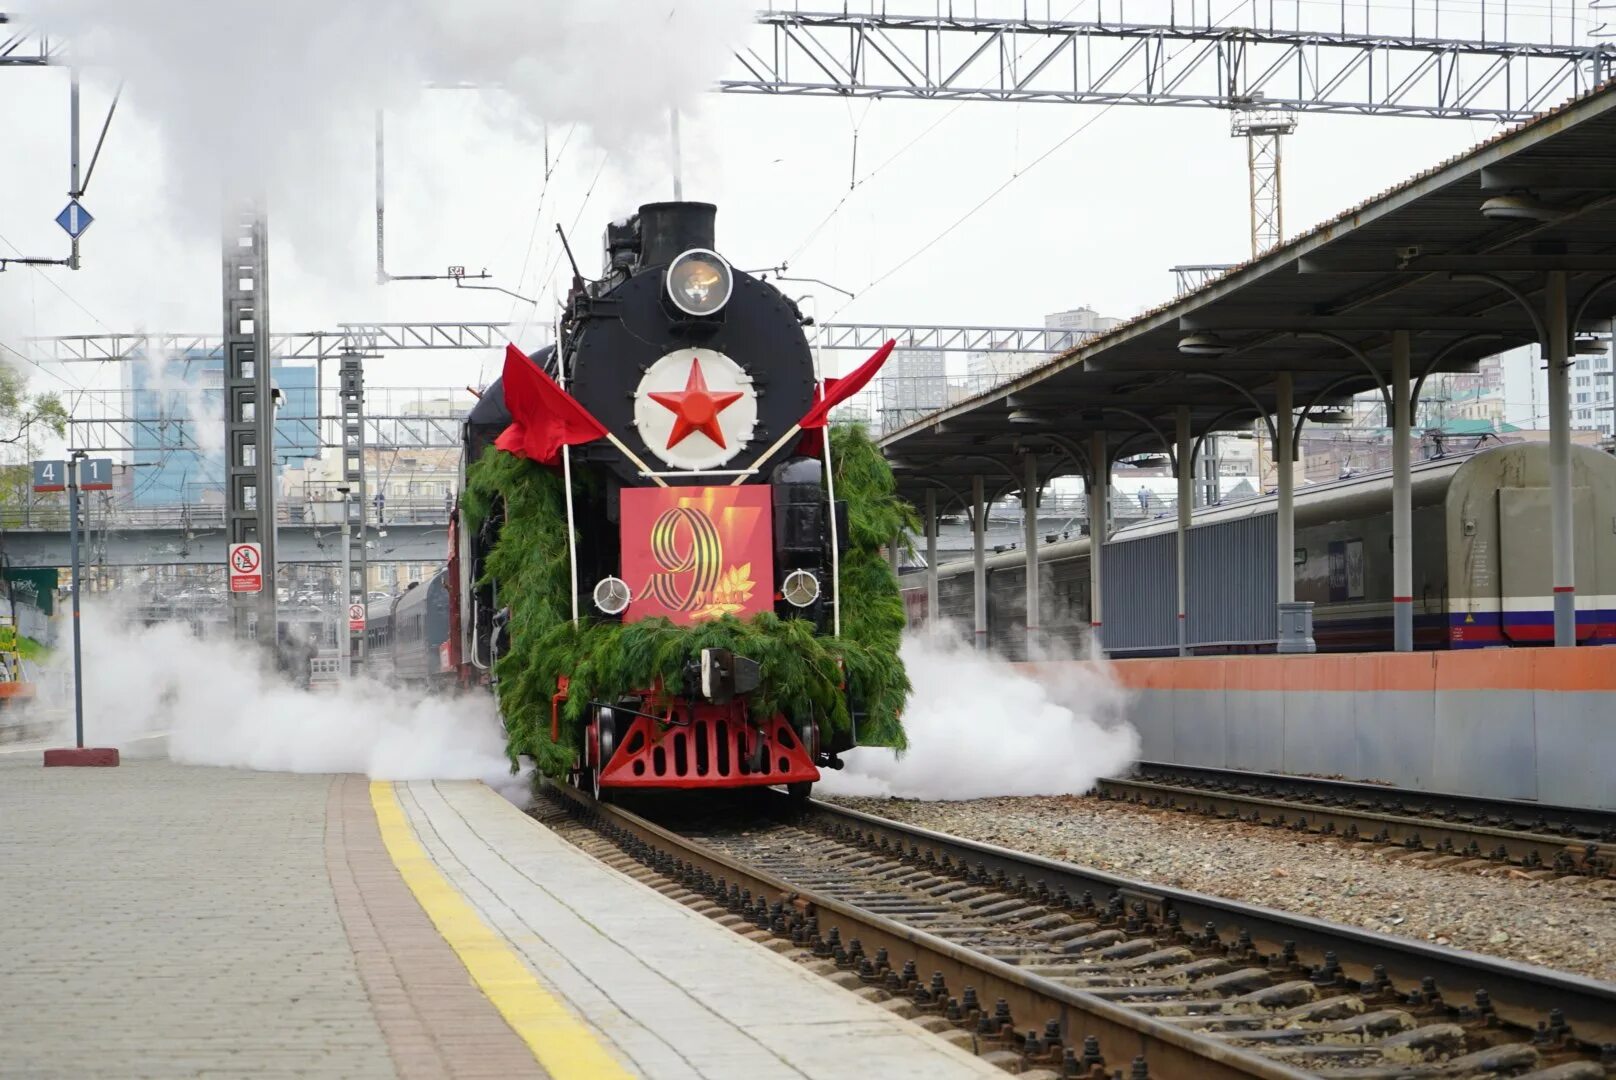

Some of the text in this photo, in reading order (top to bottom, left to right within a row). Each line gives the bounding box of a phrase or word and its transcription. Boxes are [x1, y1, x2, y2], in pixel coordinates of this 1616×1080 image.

[42, 463, 55, 481] 4
[90, 461, 98, 479] 1
[635, 507, 722, 612] 9
